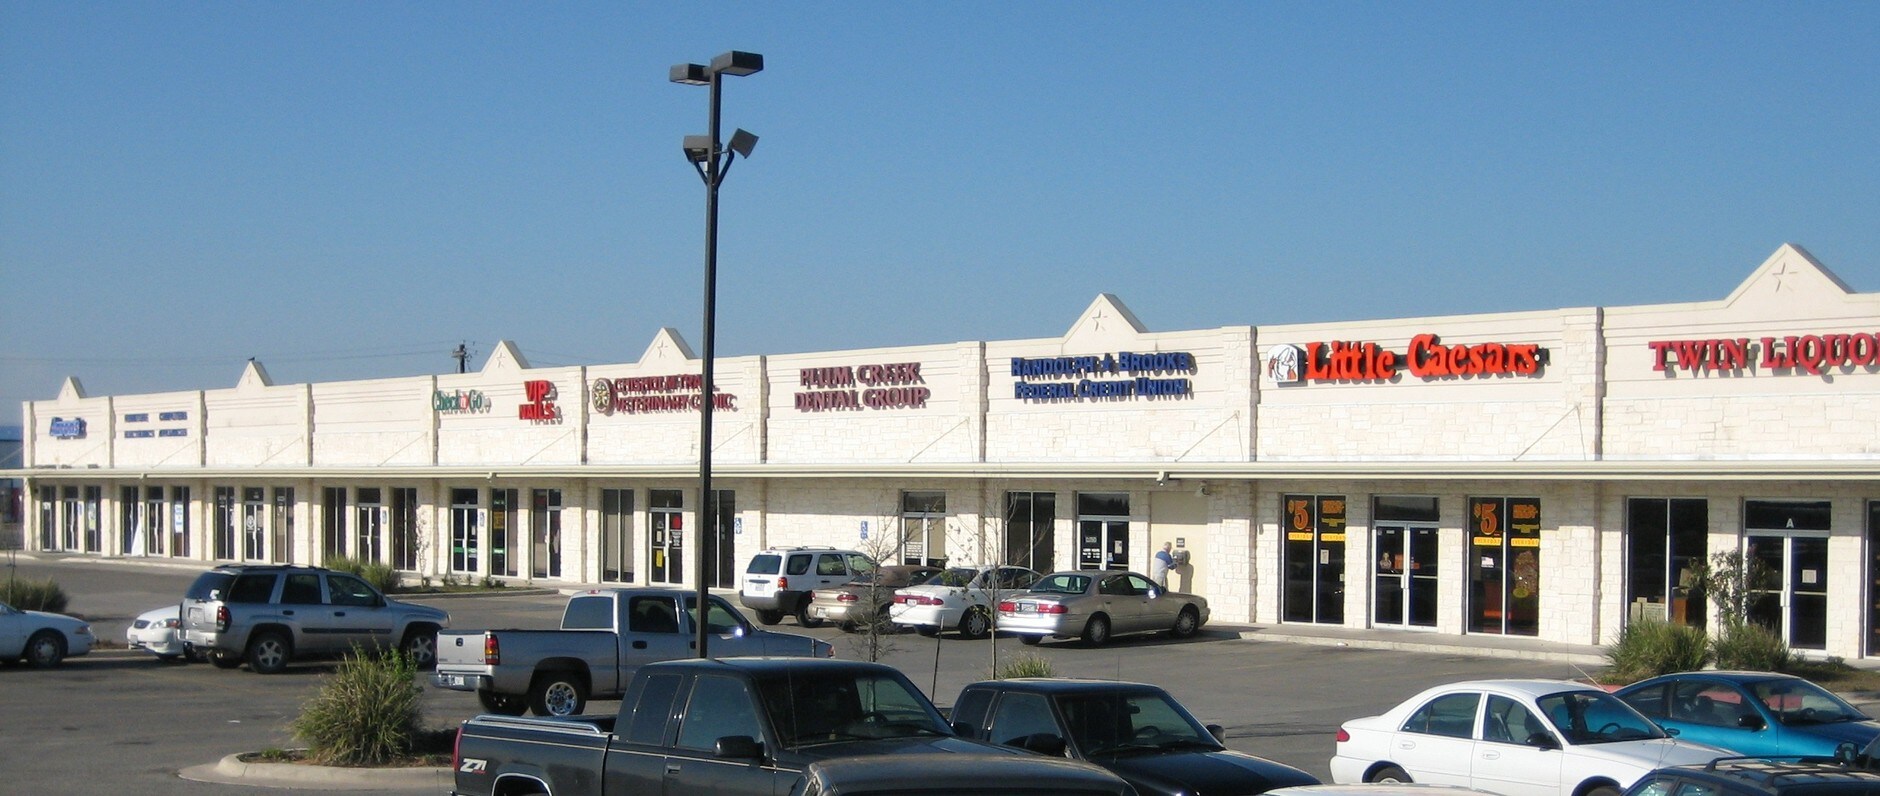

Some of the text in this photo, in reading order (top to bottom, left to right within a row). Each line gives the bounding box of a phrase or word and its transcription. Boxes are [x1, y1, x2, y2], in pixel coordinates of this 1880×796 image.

[1011, 352, 1190, 376] RANDOLPH BROOKS
[1305, 334, 1537, 380] Little Caesars
[1648, 338, 1749, 371] TWIN
[800, 362, 922, 386] PLUM CREEK
[524, 380, 552, 401] VIP
[794, 387, 929, 410] DENTAL GROUP
[1015, 377, 1188, 399] FEDERAL CREDIT UNION
[519, 402, 556, 420] NAILS
[614, 393, 735, 412] VETERINARY CNIC
[1786, 518, 1795, 528] A
[460, 758, 487, 773] Z71
